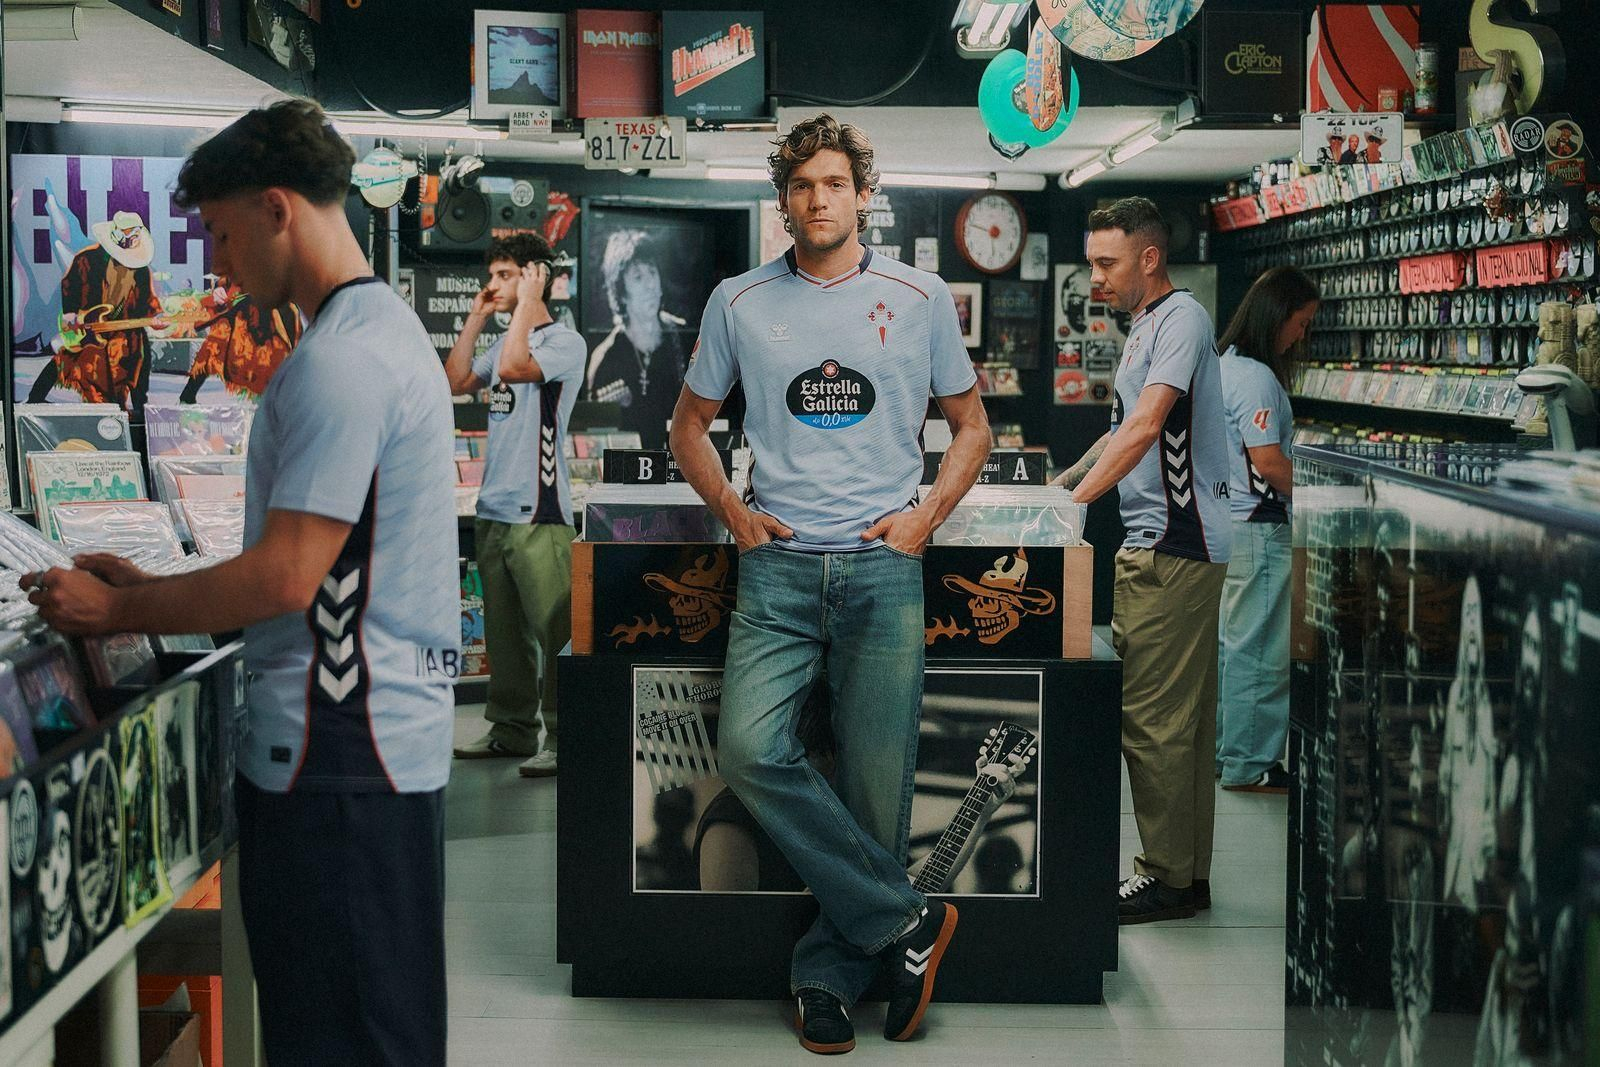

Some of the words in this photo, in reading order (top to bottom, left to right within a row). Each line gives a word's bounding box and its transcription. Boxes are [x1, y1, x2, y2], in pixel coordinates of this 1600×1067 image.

[583, 30, 617, 48] IRON
[1239, 44, 1265, 56] ERIC
[1225, 51, 1282, 75] CLAPTON
[616, 123, 656, 135] TEXAS
[1514, 127, 1541, 143] RADAR
[592, 136, 630, 160] 817
[641, 136, 680, 160] ZZL
[800, 379, 861, 395] Estrella
[803, 395, 859, 412] Galicia
[638, 457, 653, 480] B
[1012, 457, 1030, 480] A
[693, 681, 722, 694] GEOR
[686, 688, 721, 704] THORO
[639, 713, 668, 727] COCAINE
[642, 724, 661, 736] MOVE
[661, 722, 668, 730] IT
[669, 720, 679, 728] ON
[679, 714, 697, 725] OVER
